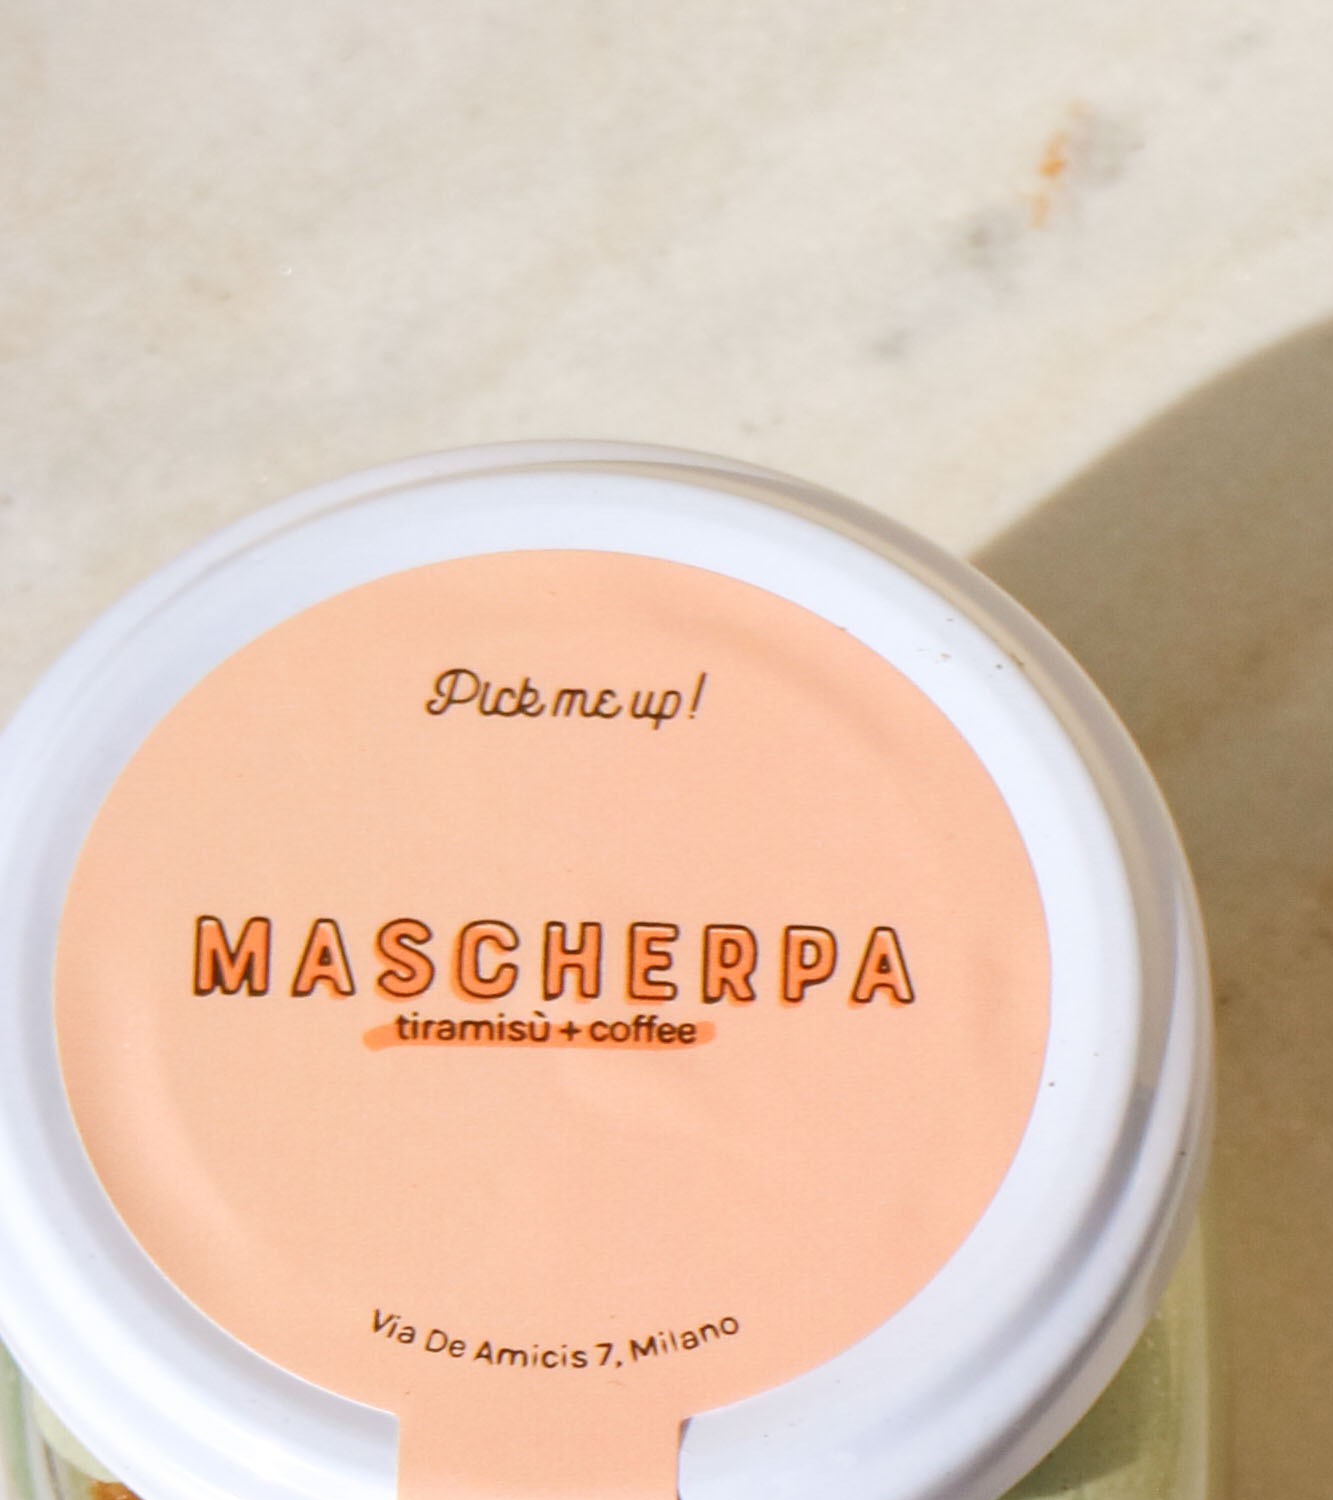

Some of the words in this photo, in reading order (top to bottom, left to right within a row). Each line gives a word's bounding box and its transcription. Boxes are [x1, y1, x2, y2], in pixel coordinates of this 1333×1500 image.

[425, 667, 546, 718] Pick
[551, 687, 623, 719] me
[630, 671, 707, 731] up!
[192, 914, 917, 1006] MASCHERPA
[395, 1009, 551, 1043] tiramisù
[558, 1020, 582, 1043] +
[588, 1013, 698, 1045] coffee
[371, 1308, 417, 1344] Via
[424, 1327, 467, 1358] De
[473, 1339, 589, 1369] Amicis
[595, 1342, 624, 1369] 7,
[629, 1315, 741, 1362] Milano
